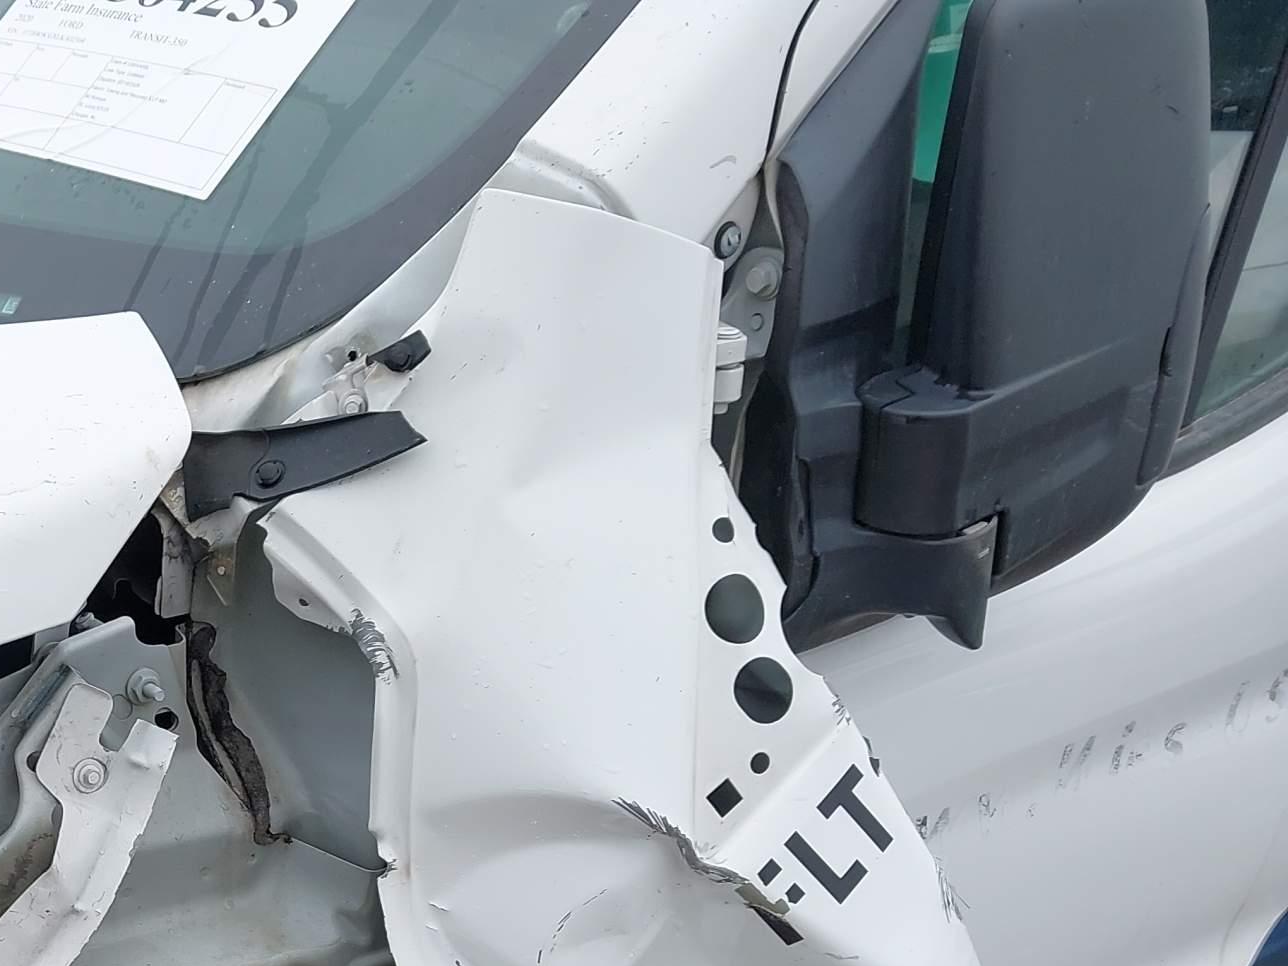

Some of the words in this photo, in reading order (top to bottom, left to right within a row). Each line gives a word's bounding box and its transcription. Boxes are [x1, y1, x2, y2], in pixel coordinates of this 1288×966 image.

[53, 0, 84, 15] Farm
[86, 3, 143, 24] Insurance
[57, 18, 84, 30] FORD
